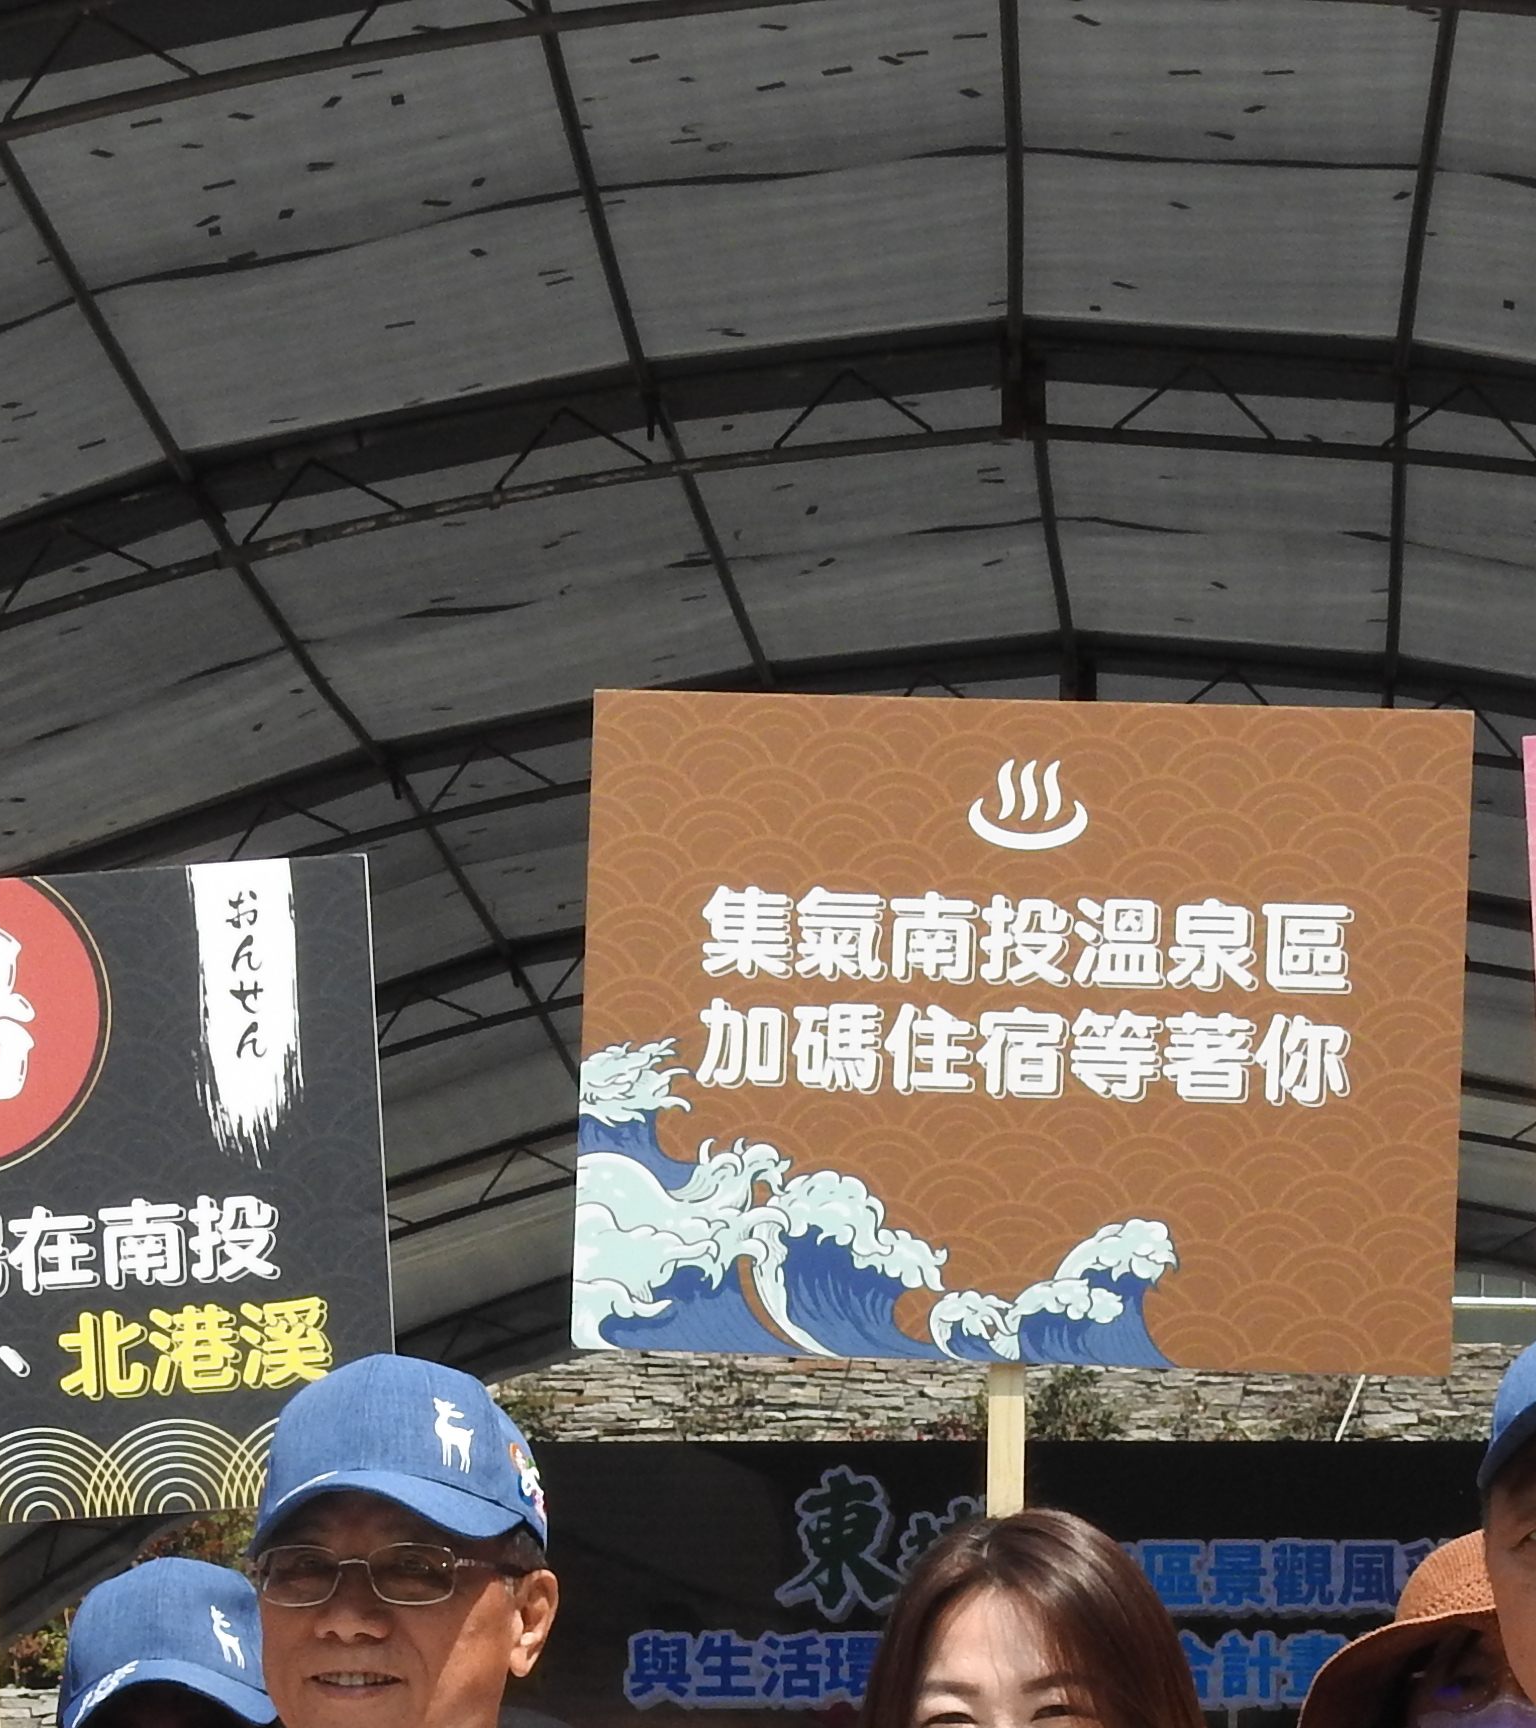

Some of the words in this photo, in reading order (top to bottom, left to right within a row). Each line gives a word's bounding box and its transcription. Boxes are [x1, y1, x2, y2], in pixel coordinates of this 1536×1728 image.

[225, 889, 268, 1059] おんせん
[700, 884, 1354, 994] 集氣南投溫泉區
[695, 997, 1351, 1108] 加碼住宿等著你
[1120, 1539, 1447, 1612] 區景觀風
